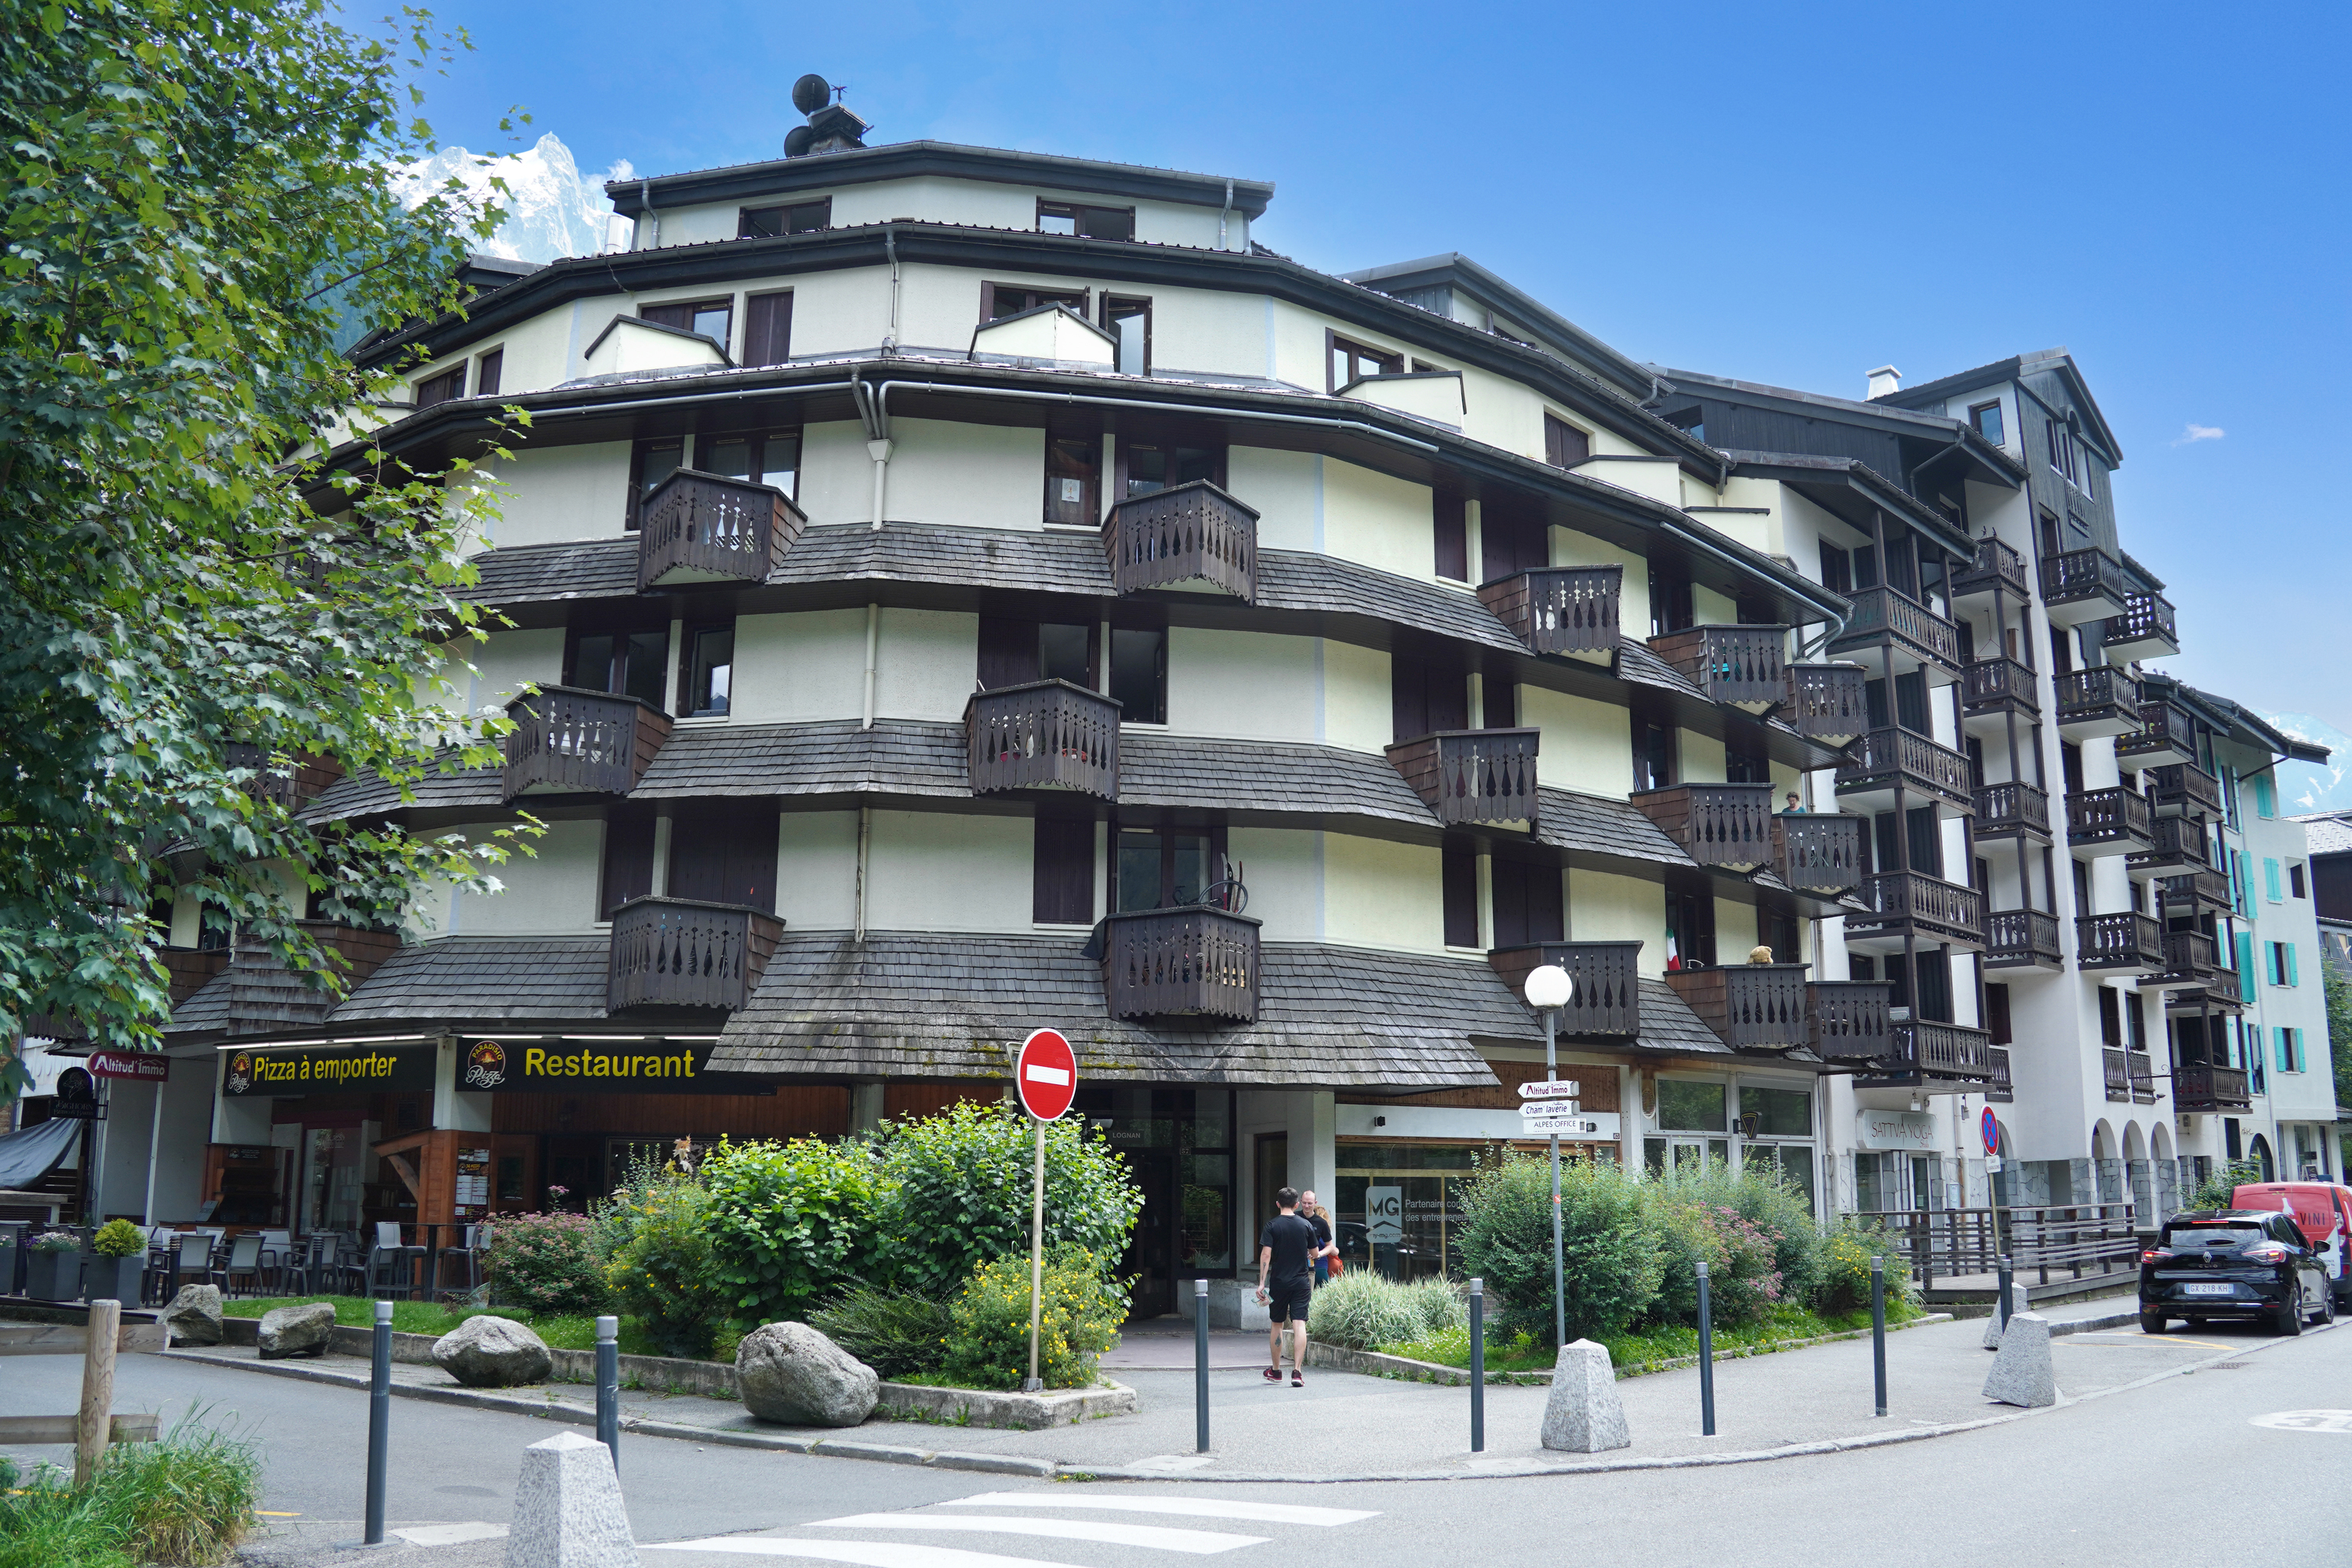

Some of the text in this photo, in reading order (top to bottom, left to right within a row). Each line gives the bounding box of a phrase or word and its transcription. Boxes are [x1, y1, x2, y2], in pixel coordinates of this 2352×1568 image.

[472, 1044, 503, 1060] PARADISIO
[254, 1051, 397, 1085] Pizza à emporter
[525, 1048, 695, 1077] Restaurant
[229, 1073, 249, 1094] Pizza
[466, 1065, 506, 1088] Pizza
[1545, 1105, 1567, 1113] laverie
[1871, 1119, 1933, 1139] SATTVA YOGA
[1368, 1197, 1399, 1217] MG
[1405, 1200, 1444, 1208] Partenaire
[1405, 1213, 1470, 1224] des entrepreneur
[2299, 1213, 2325, 1225] VINI
